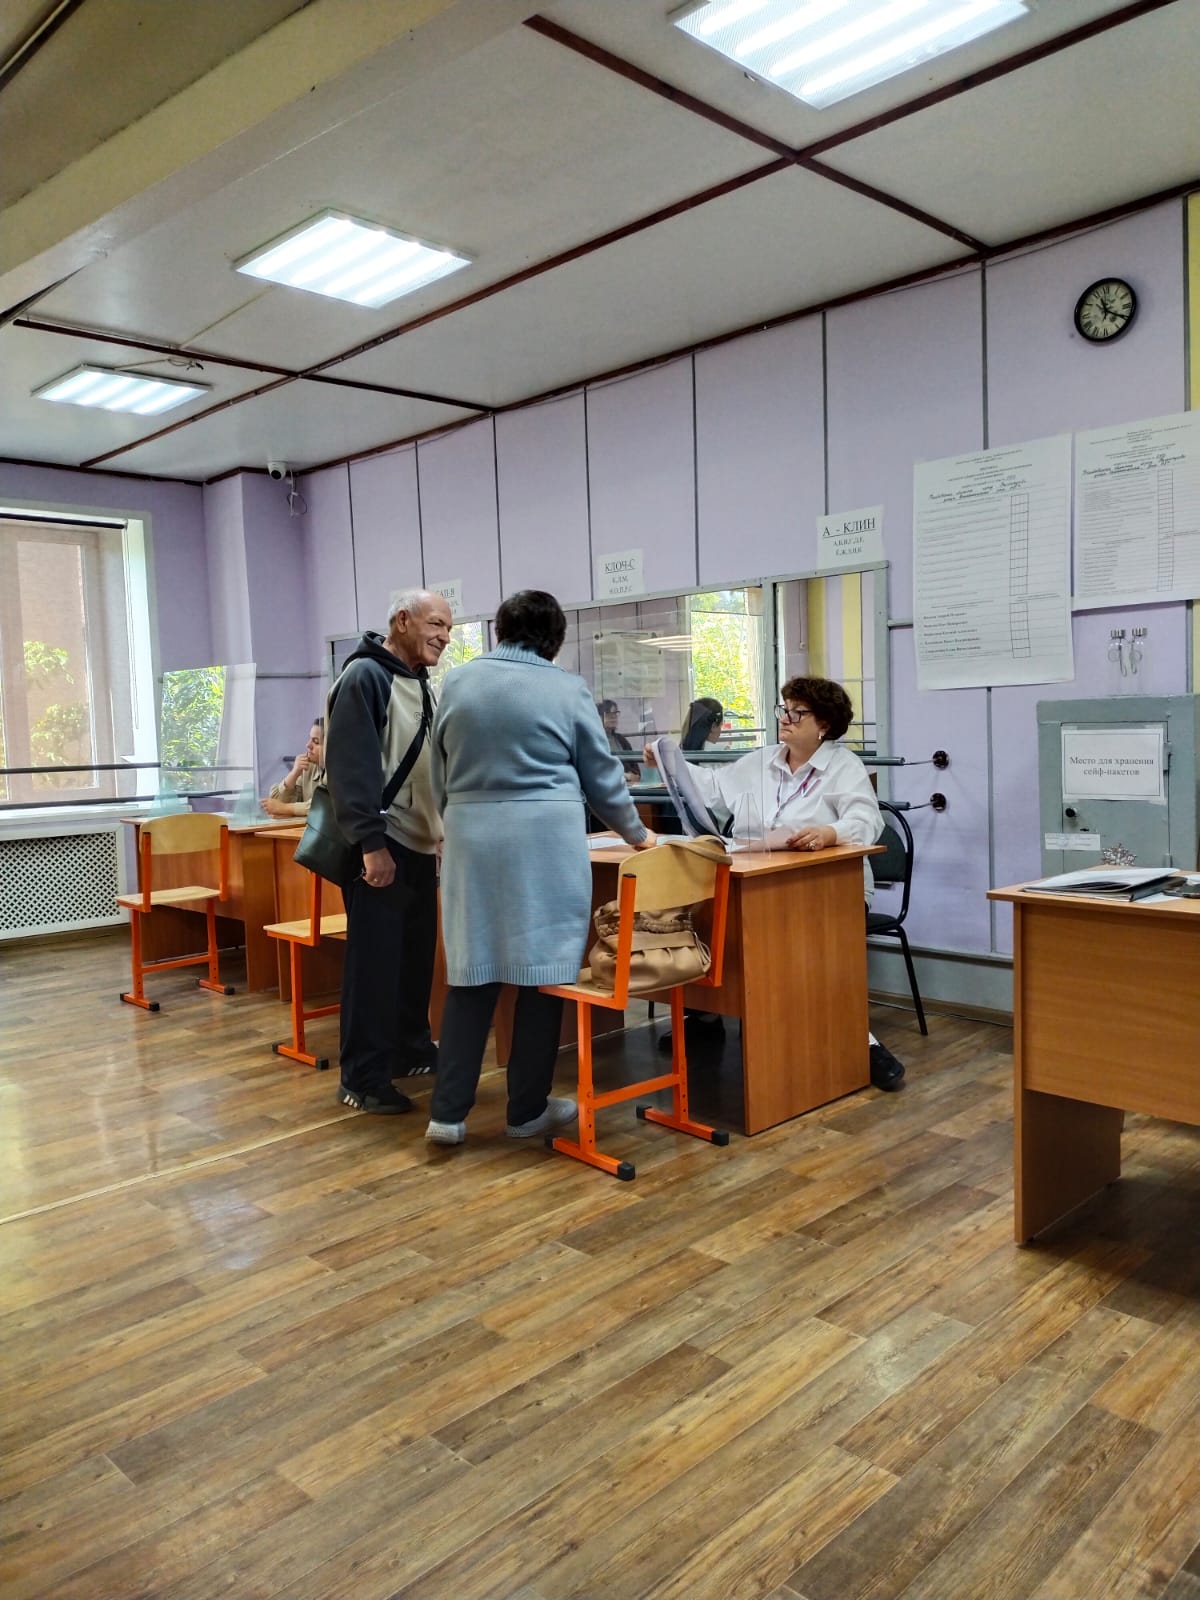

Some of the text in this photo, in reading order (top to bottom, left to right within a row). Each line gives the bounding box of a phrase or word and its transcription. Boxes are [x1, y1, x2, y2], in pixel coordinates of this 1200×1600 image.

[822, 526, 830, 537] А
[843, 517, 875, 533] КЛИН
[1069, 756, 1154, 767] Место для хранения
[1083, 767, 1140, 777] сейф-пакетов
